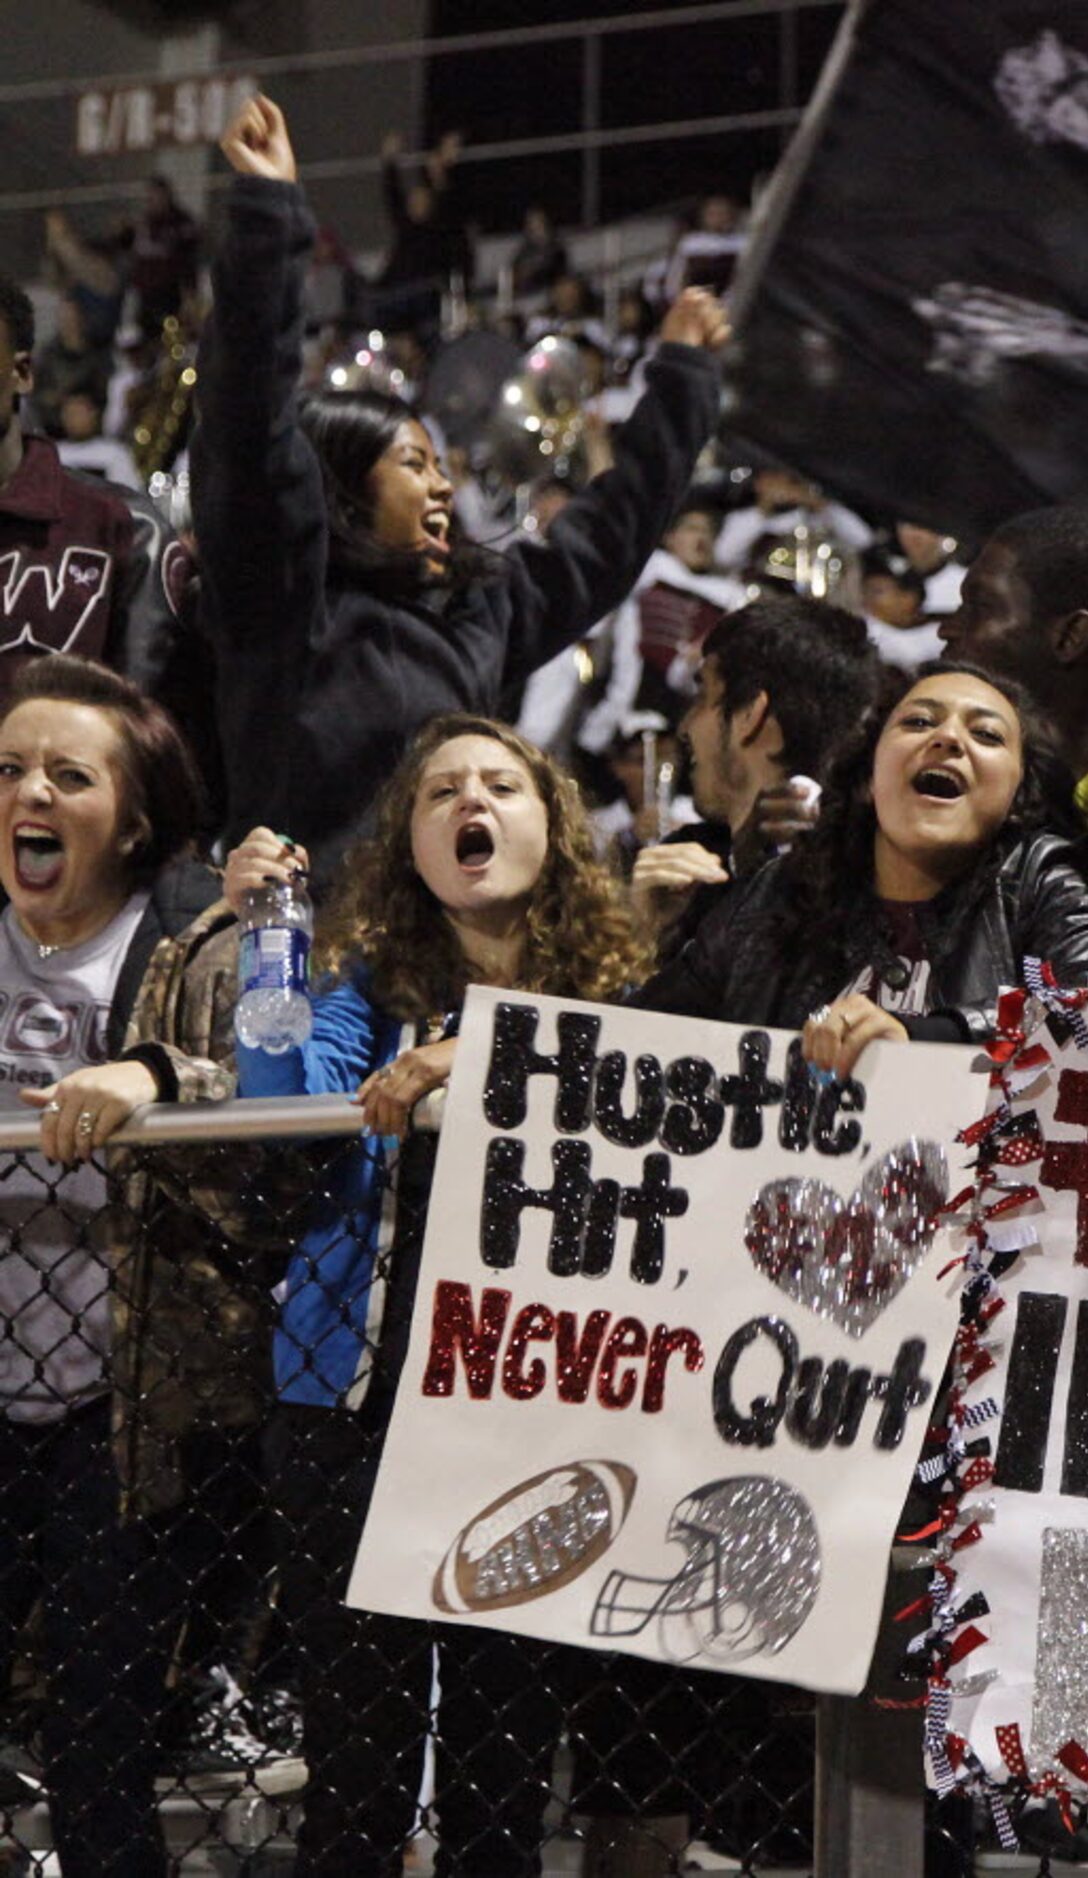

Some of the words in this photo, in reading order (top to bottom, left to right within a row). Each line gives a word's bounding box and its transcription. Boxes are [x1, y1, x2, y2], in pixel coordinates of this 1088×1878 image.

[483, 1002, 871, 1160] Hustle,
[480, 1136, 690, 1290] Hit,
[422, 1280, 705, 1414] Never
[713, 1315, 932, 1450] Quit
